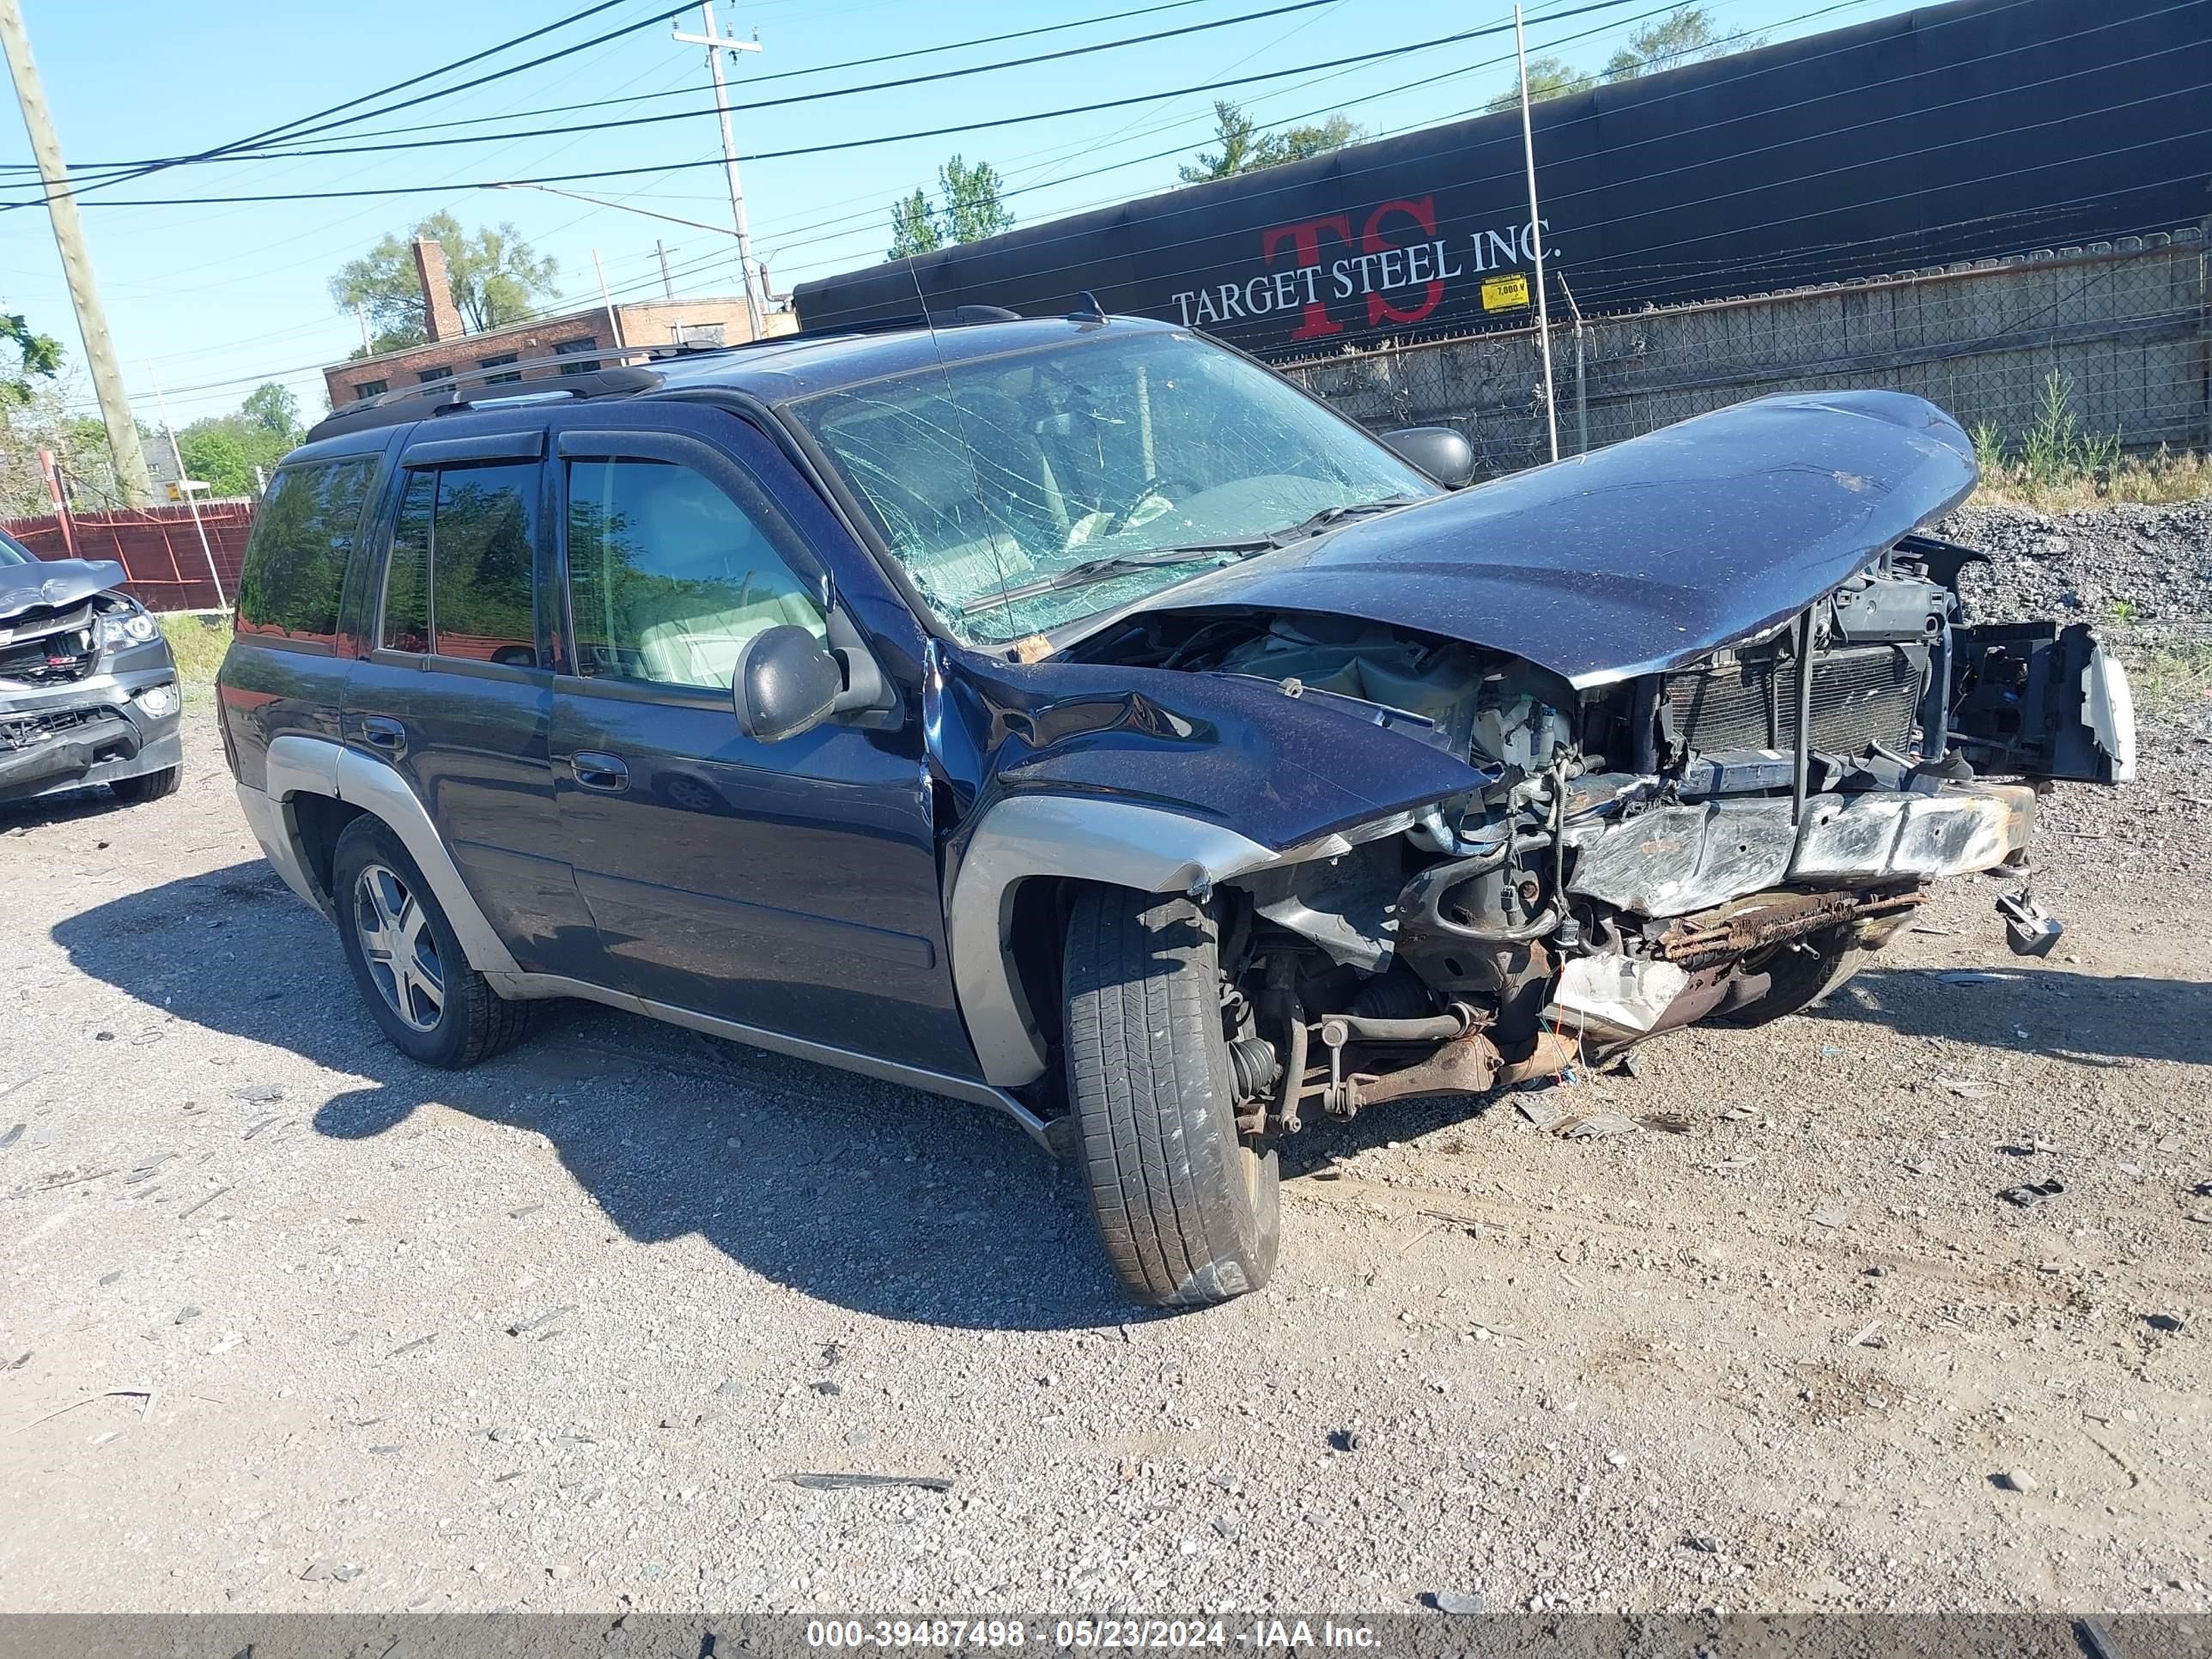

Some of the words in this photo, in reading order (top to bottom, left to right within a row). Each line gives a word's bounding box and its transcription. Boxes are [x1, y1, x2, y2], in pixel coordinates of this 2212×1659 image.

[1172, 265, 1322, 327] TARGET
[1333, 240, 1462, 299] STEEL
[1472, 219, 1562, 274] INC.
[1263, 196, 1445, 341] TS
[1498, 284, 1518, 295] 7,000
